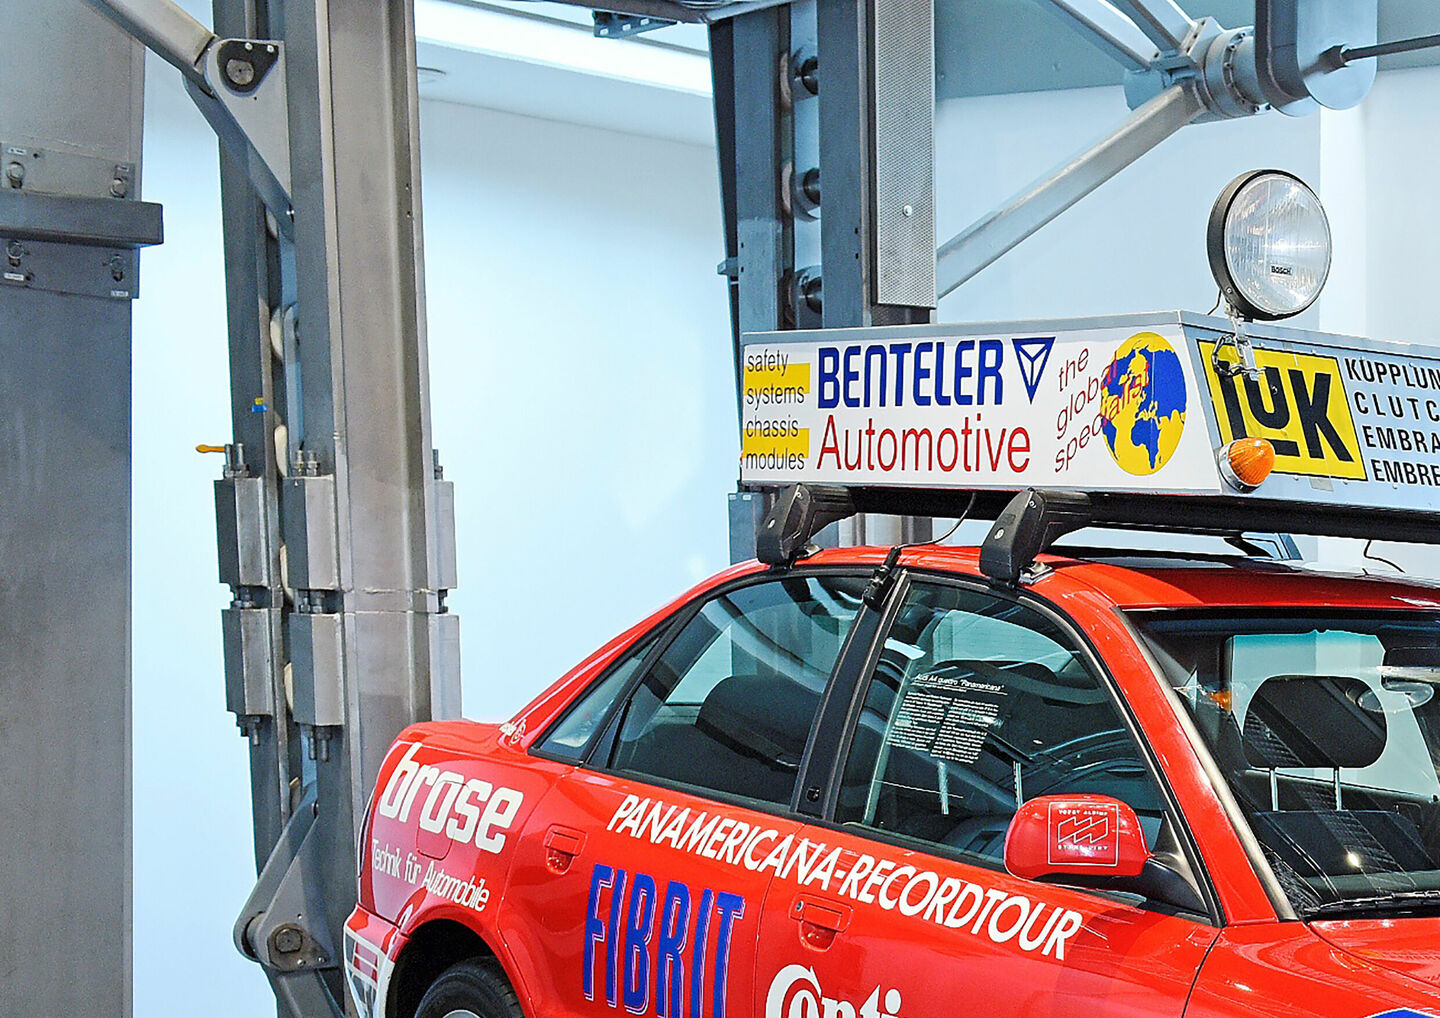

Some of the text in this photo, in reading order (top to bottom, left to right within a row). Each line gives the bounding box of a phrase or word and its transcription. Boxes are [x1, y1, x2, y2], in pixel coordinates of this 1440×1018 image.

[1271, 266, 1292, 275] BOSCH
[746, 351, 789, 375] safety
[817, 339, 1004, 408] BENTELER
[1059, 348, 1089, 391] the
[746, 384, 805, 406] systems
[1055, 361, 1150, 473] specialist
[1057, 351, 1117, 440] global
[746, 415, 799, 438] chassis
[816, 413, 1031, 472] Automotive
[745, 450, 805, 470] modules
[379, 743, 523, 854] brose
[371, 838, 490, 912] Technik für Automobile
[607, 794, 1083, 960] PANAMERICANA-RECORDTOUR
